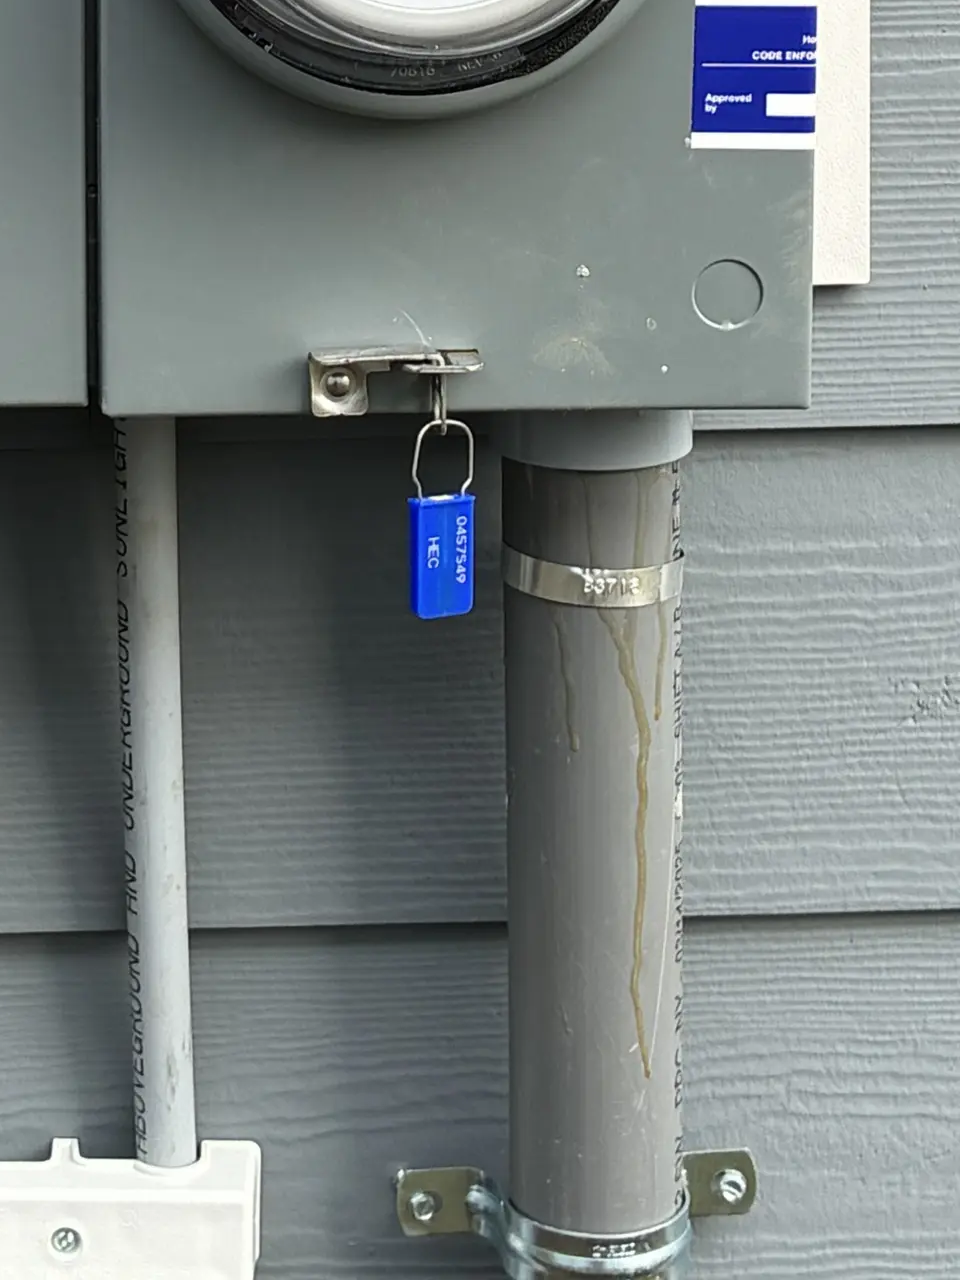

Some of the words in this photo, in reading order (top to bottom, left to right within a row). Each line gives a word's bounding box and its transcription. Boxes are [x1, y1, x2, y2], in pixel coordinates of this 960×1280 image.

[752, 50, 783, 61] CODE
[705, 93, 753, 104] Approved
[427, 536, 440, 569] HEC
